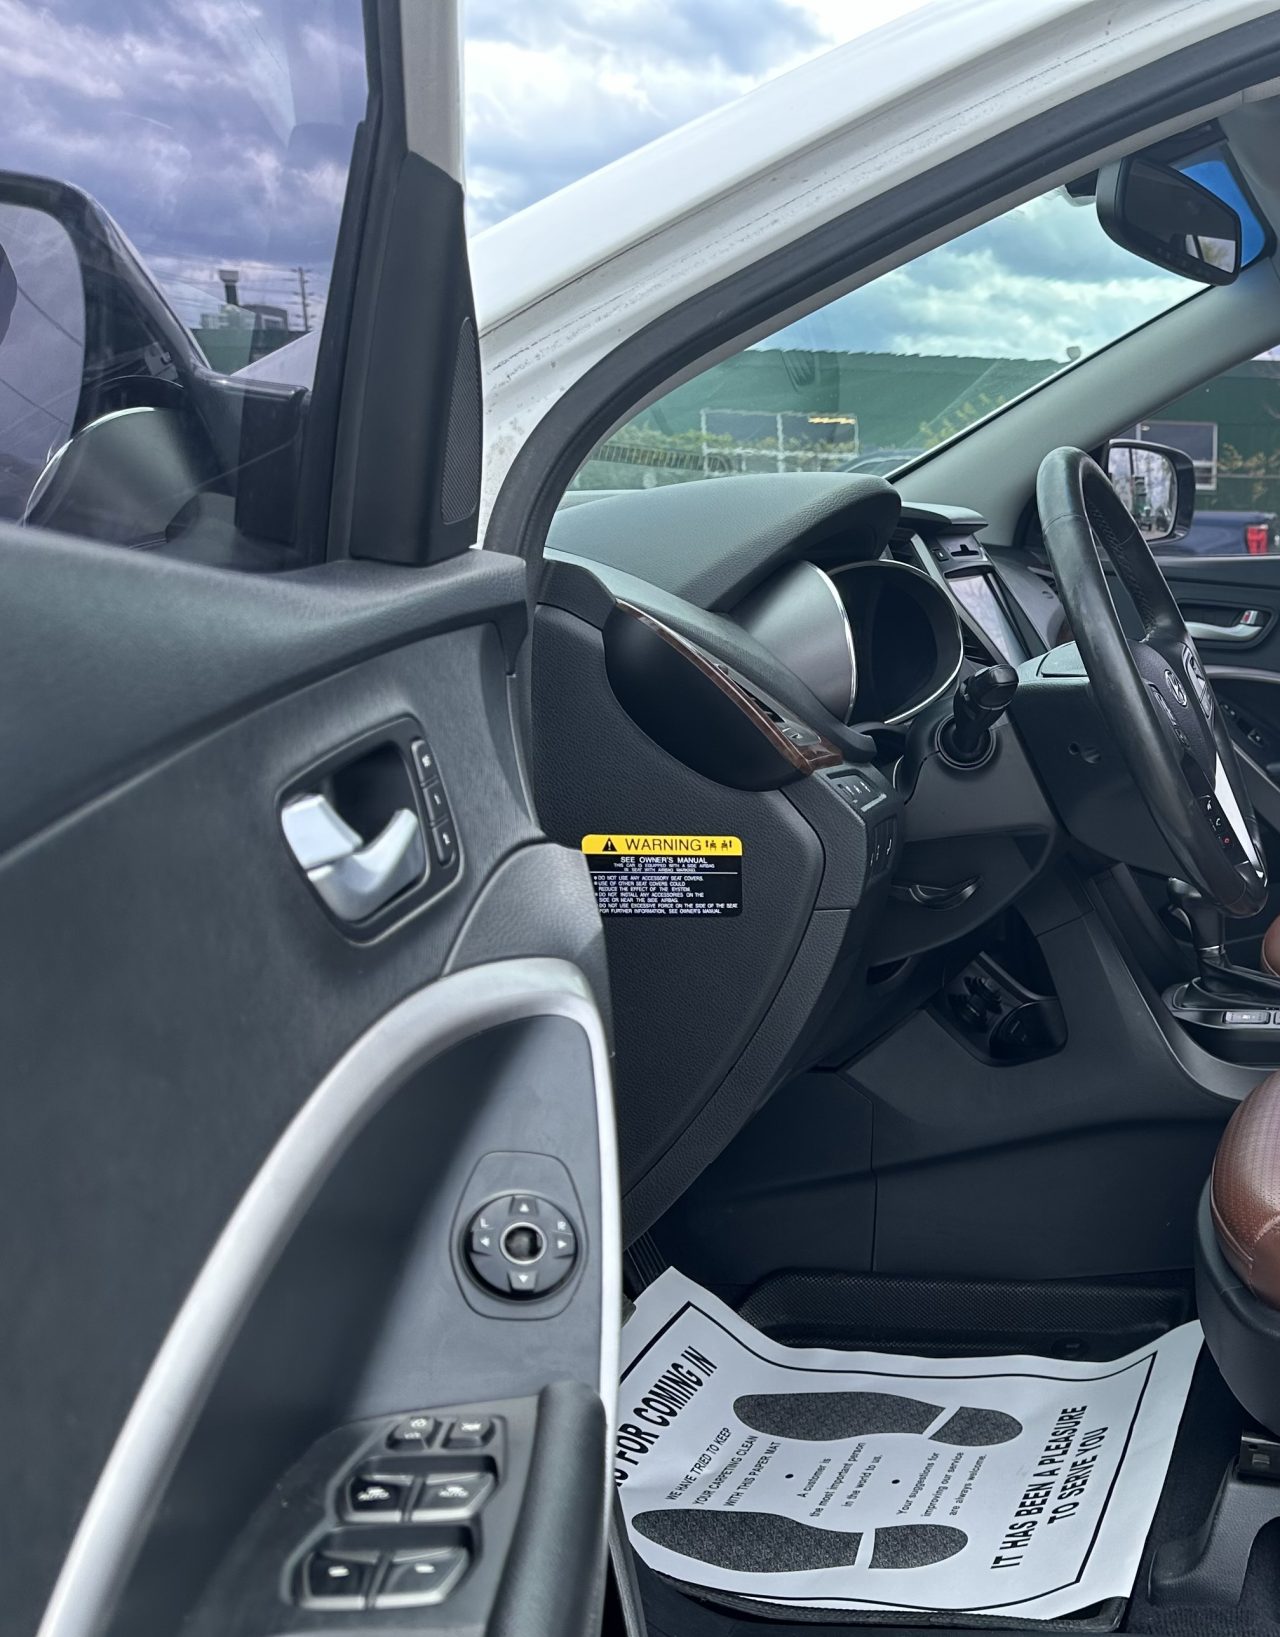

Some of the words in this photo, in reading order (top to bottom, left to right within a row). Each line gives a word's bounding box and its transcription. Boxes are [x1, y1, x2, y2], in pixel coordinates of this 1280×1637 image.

[624, 838, 702, 850] WARNING
[480, 1218, 489, 1228] L
[557, 1221, 566, 1230] R
[680, 1345, 718, 1377] IN
[632, 1362, 704, 1427] COMING
[616, 1423, 660, 1466] FOR
[1038, 1405, 1088, 1466] PLEASURE
[1075, 1426, 1108, 1456] YOU
[665, 1490, 682, 1500] WE
[675, 1474, 697, 1494] HAVE
[690, 1454, 712, 1475] TRIED
[706, 1444, 720, 1454] TO
[714, 1427, 732, 1446] KEEP
[692, 1490, 716, 1505] YOUR
[708, 1457, 742, 1490] CARPETING
[736, 1436, 758, 1456] CLEAN
[723, 1492, 744, 1506] WITH
[737, 1478, 756, 1492] THIS
[748, 1456, 772, 1476] PAPER
[764, 1442, 782, 1454] MAT
[803, 1464, 827, 1492] customer
[810, 1507, 824, 1518] the
[819, 1488, 836, 1506] most
[831, 1462, 853, 1491] important
[848, 1442, 866, 1462] person
[847, 1490, 861, 1503] the
[856, 1470, 872, 1490] world
[874, 1454, 884, 1464] us.
[896, 1500, 914, 1516] Your
[908, 1462, 934, 1500] suggestions
[928, 1452, 940, 1462] for
[921, 1484, 948, 1517] improving
[941, 1474, 952, 1485] our
[949, 1451, 964, 1476] service
[949, 1506, 961, 1516] are
[955, 1482, 973, 1505] always
[968, 1454, 988, 1482] welcome.
[1032, 1467, 1061, 1477] A
[1057, 1454, 1098, 1500] SERVE
[1014, 1480, 1056, 1518] BEEN
[1046, 1502, 1080, 1525] TO
[999, 1520, 1038, 1550] HAS
[990, 1555, 1024, 1569] IT
